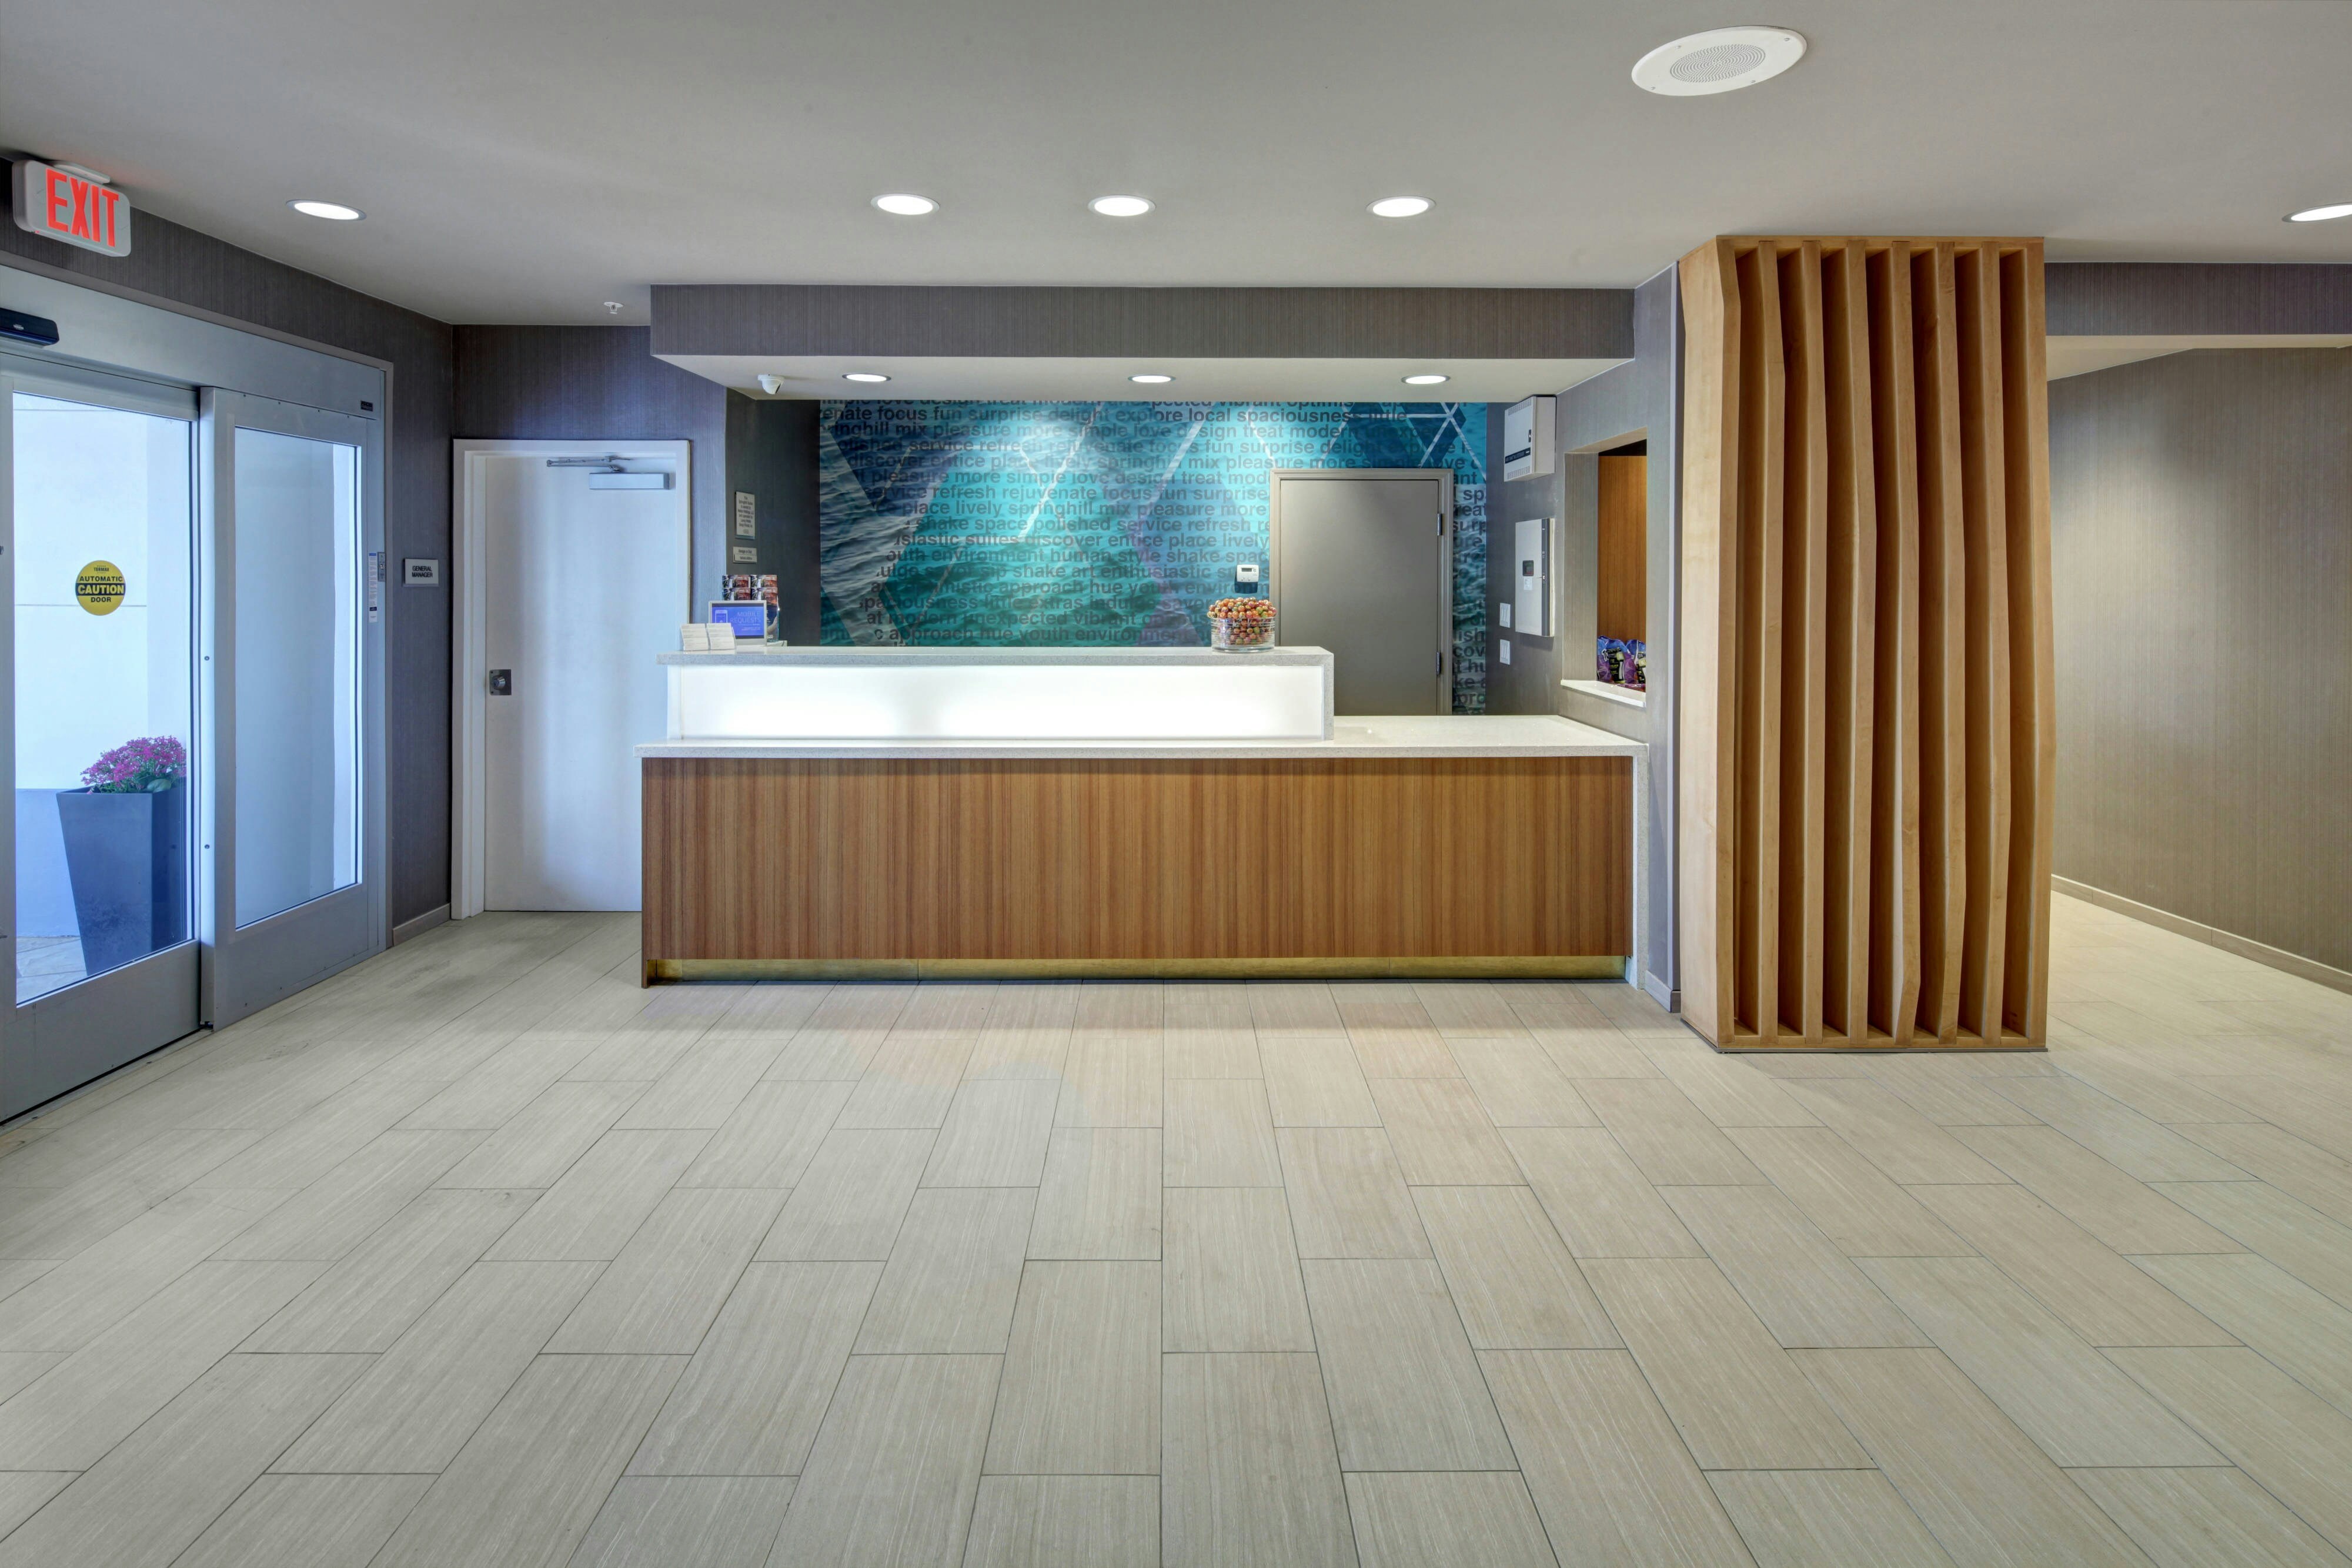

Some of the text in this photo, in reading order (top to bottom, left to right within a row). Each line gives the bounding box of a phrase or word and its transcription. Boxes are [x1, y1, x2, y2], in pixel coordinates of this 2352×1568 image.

[46, 168, 119, 248] EXIT
[820, 406, 872, 420] enate
[878, 406, 927, 420] focus
[934, 406, 961, 420] fun
[968, 407, 1047, 424] surprise
[1048, 407, 1110, 425] delight
[1115, 407, 1183, 424] explore
[1189, 408, 1230, 422] local
[1237, 408, 1362, 427] spaciousness
[896, 422, 927, 436] mix
[934, 422, 1011, 439] pleasure
[1017, 424, 1063, 437] more
[1068, 423, 1128, 440] simple
[1134, 423, 1171, 437] love
[1177, 424, 1237, 442] dsign
[1242, 424, 1284, 438] treat
[910, 439, 974, 451] service
[980, 438, 1042, 452] refresh
[1205, 440, 1234, 454] fun
[1240, 440, 1314, 457] surprise
[848, 453, 924, 467] discover
[930, 454, 985, 467] entice
[1189, 455, 1220, 469] mix
[1227, 455, 1304, 472] pleasure
[1309, 457, 1355, 469] more
[873, 469, 949, 486] pleasure
[955, 471, 1000, 483] more
[1007, 470, 1066, 487] simple
[1182, 471, 1222, 484] treat
[1228, 471, 1270, 484] mod
[933, 485, 995, 499] refresh
[1003, 485, 1097, 502] rejuvenate
[1102, 486, 1152, 500] focus
[1193, 486, 1268, 503] surprise
[903, 500, 950, 517] place
[956, 500, 1002, 517] lively
[1008, 500, 1093, 518] springhill
[1100, 502, 1130, 516] mix
[1221, 504, 1267, 516] more
[916, 516, 969, 530] shake
[974, 519, 1027, 533] space
[1034, 516, 1111, 533] polished
[1117, 517, 1182, 531] service
[1188, 517, 1251, 531] refresh
[965, 532, 1018, 546] suites
[1025, 533, 1101, 547] discover
[1108, 533, 1163, 547] entice
[1169, 533, 1217, 550] place
[1223, 533, 1269, 550] lively
[931, 549, 1044, 562] environment
[1050, 548, 1112, 562] human
[1118, 549, 1161, 566] style
[1167, 549, 1220, 563] shake
[877, 562, 918, 580] ulge
[1013, 564, 1065, 578] shake
[1071, 564, 1096, 578] art
[1101, 564, 1211, 579] enthusiastic
[78, 584, 124, 594] CAUTION
[1000, 580, 1083, 596] approach
[1090, 579, 1122, 593] hue
[964, 611, 1067, 628] unexpected
[1073, 611, 1135, 625] vibrant
[890, 626, 973, 644] approach
[980, 627, 1013, 641] hue
[1019, 627, 1069, 644] youth
